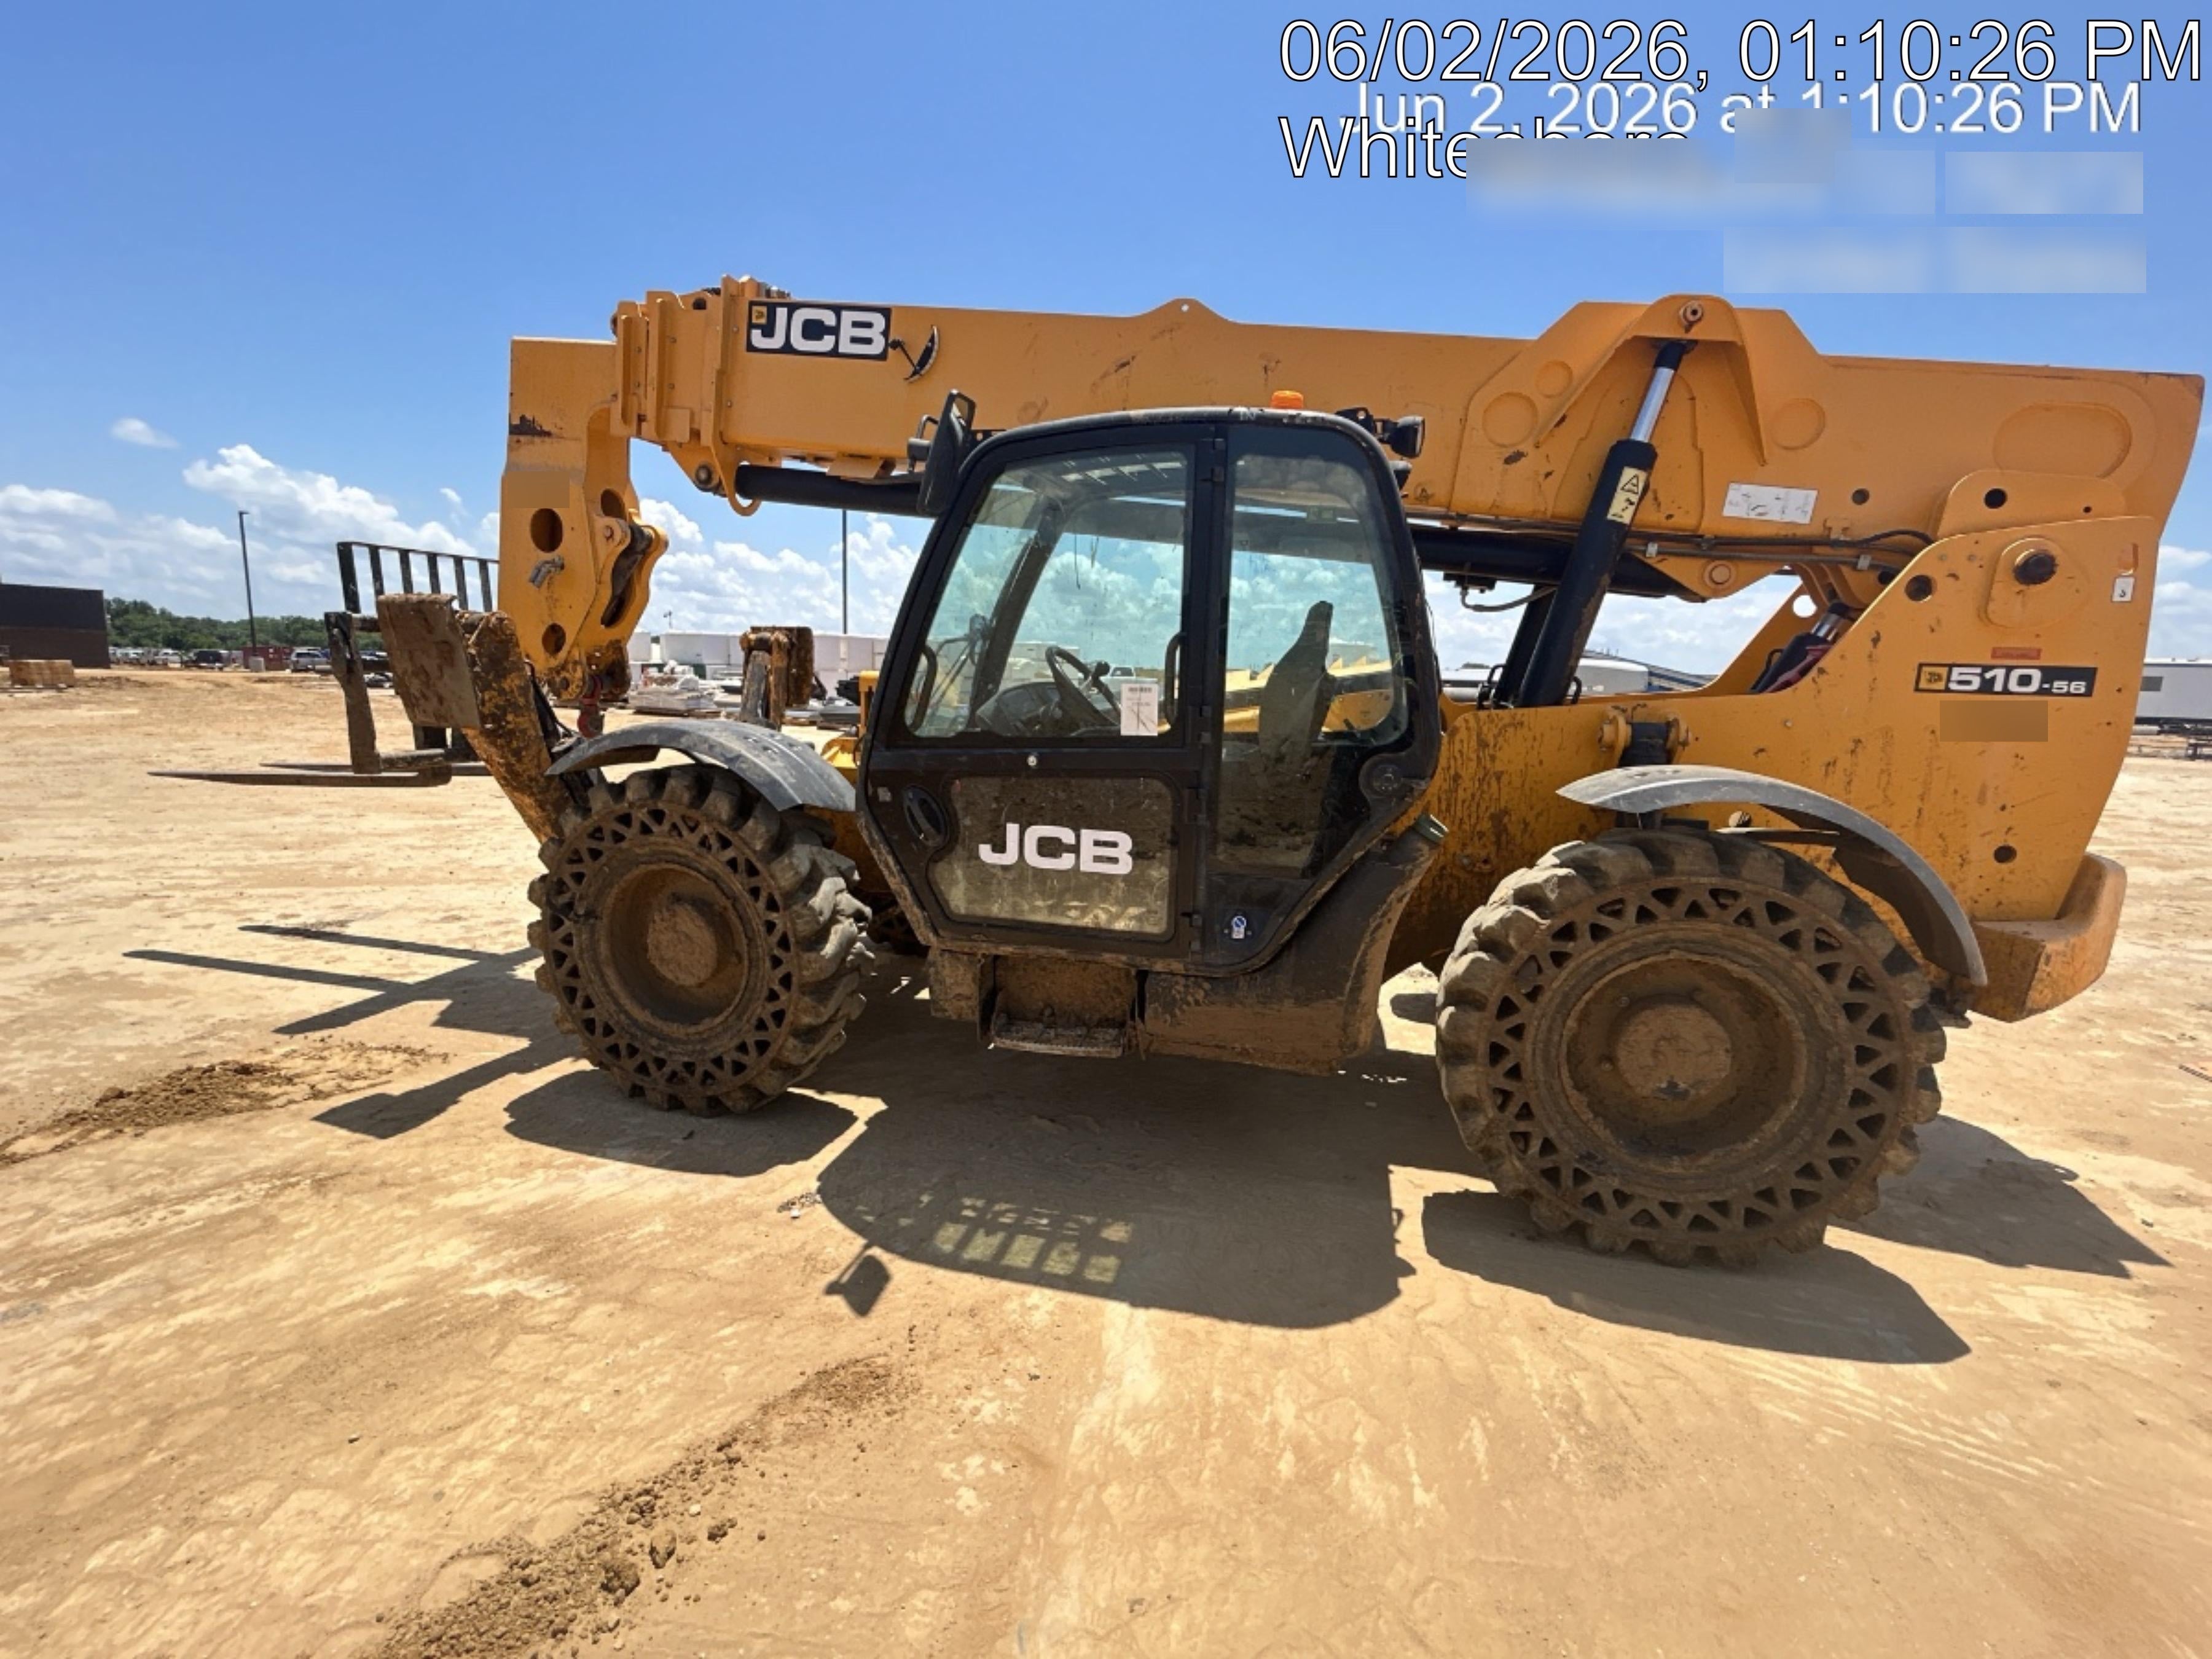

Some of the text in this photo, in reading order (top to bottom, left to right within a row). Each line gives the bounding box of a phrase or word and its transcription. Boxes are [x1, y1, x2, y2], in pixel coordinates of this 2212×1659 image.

[751, 307, 885, 355] JCB
[1948, 667, 2086, 694] 510-56
[978, 823, 1132, 874] JCB
